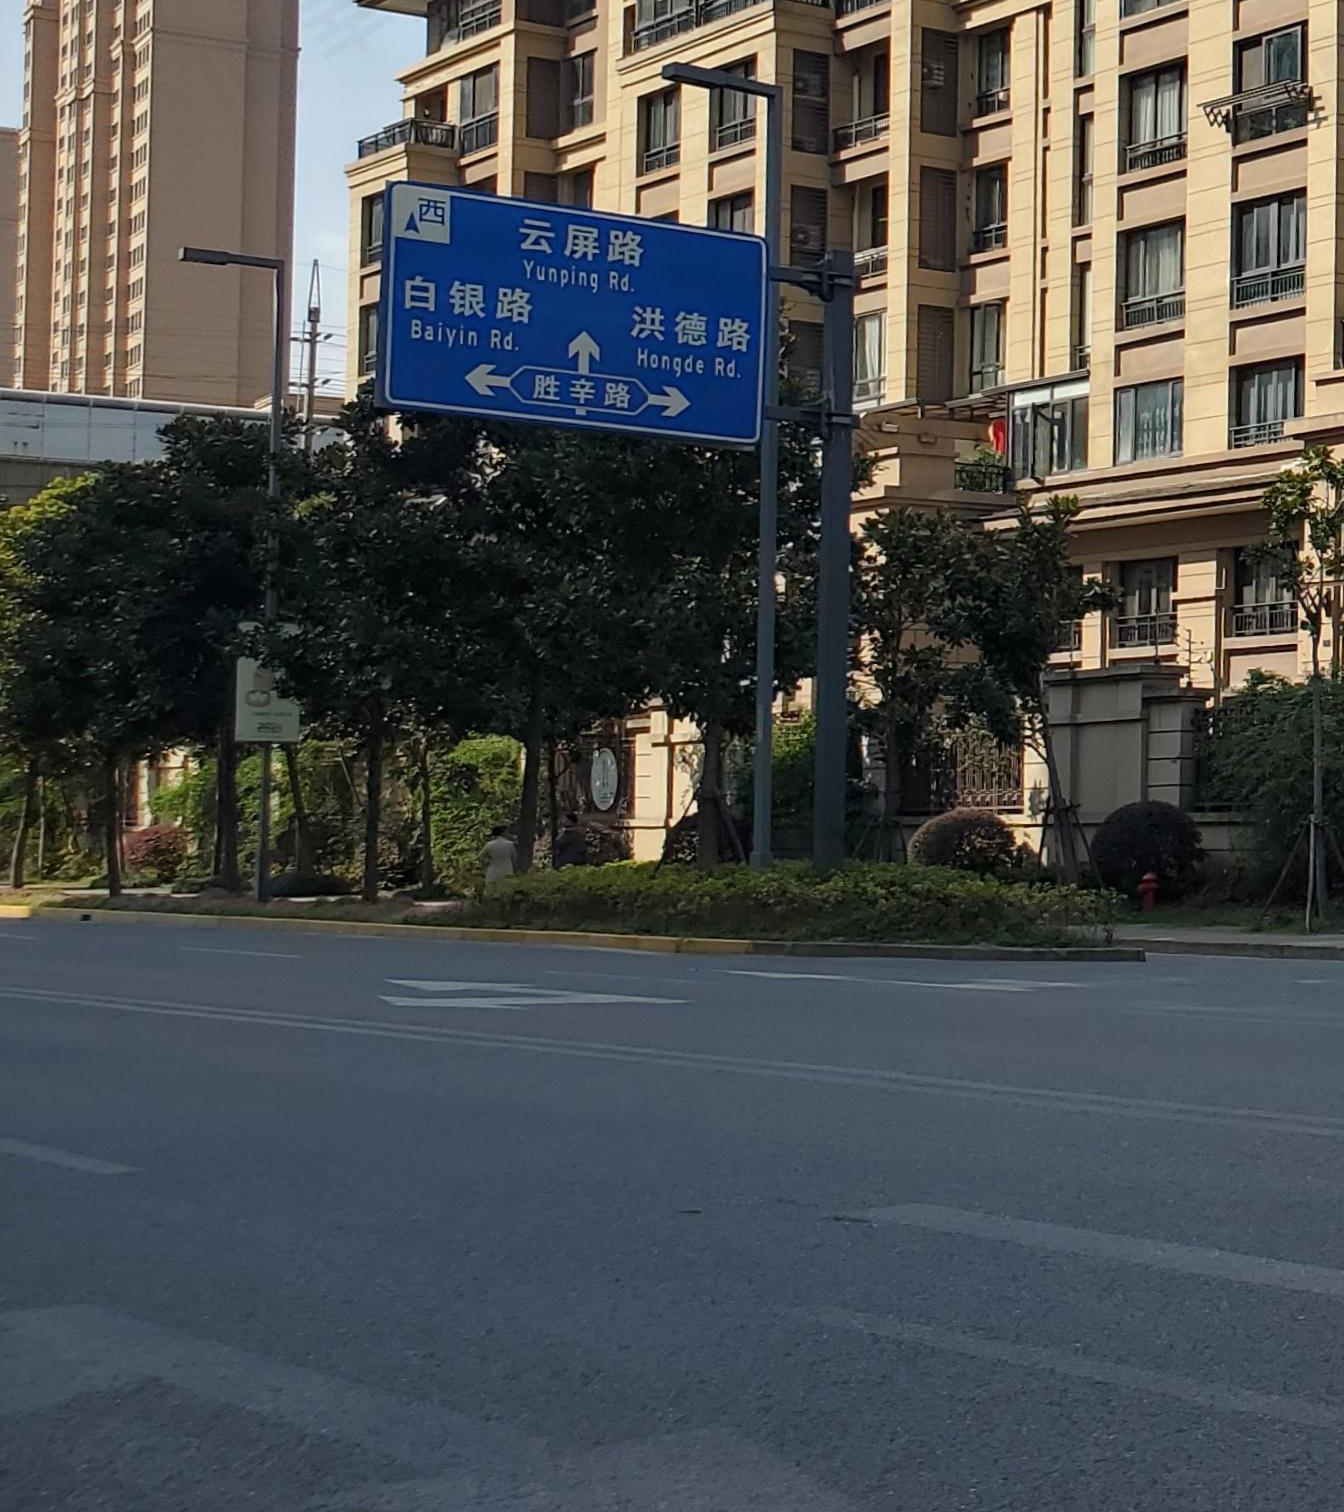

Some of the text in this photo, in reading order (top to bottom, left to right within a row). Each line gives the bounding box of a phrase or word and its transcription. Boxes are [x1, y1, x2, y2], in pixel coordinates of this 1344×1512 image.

[418, 197, 446, 225] 西
[519, 218, 645, 268] 云屏路
[523, 260, 635, 294] Yunping Rd.
[404, 276, 534, 324] 白银路
[411, 321, 519, 352] Baiyin Rd.
[629, 305, 752, 353] 洪德路
[637, 348, 741, 379] Hongde Rd.
[533, 374, 632, 409] 胜辛路
